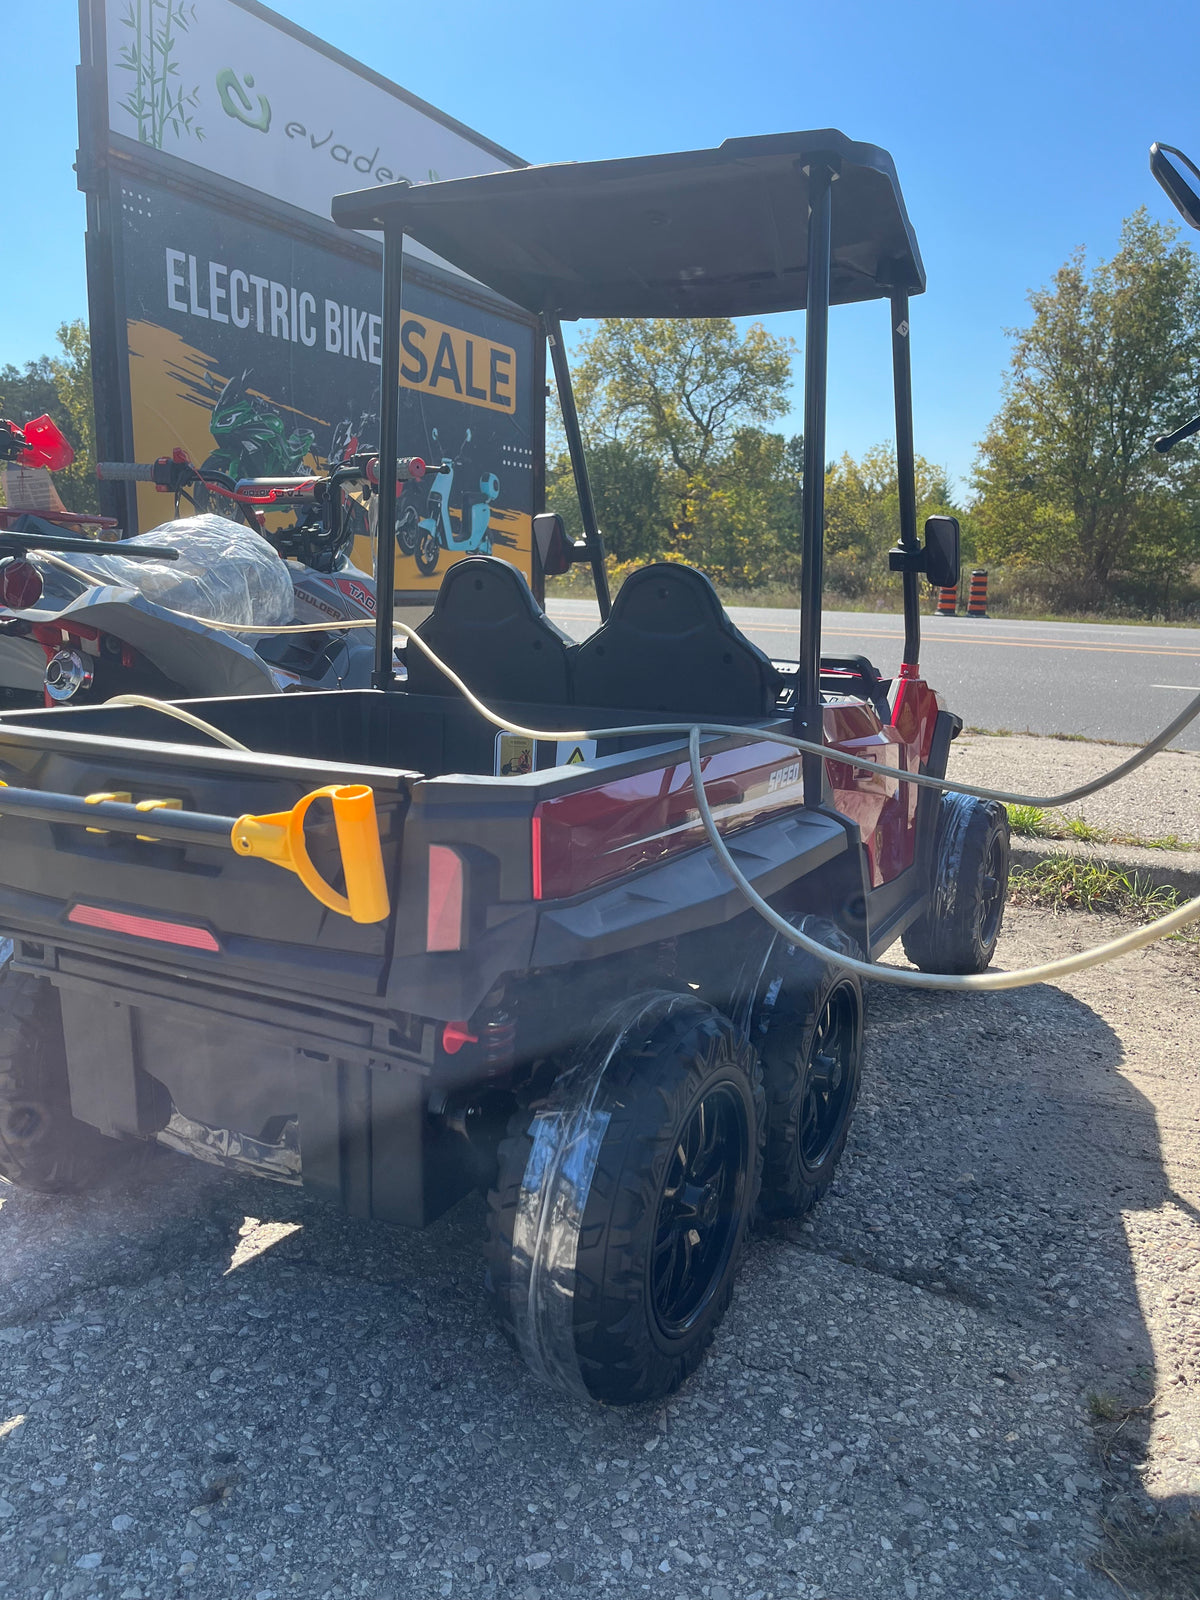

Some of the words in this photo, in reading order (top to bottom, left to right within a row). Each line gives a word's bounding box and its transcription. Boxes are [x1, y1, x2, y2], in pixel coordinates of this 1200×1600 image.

[166, 248, 316, 347] ELECTRIC
[325, 299, 382, 366] BIKE
[401, 320, 511, 407] SALE
[767, 762, 800, 794] SPEED
